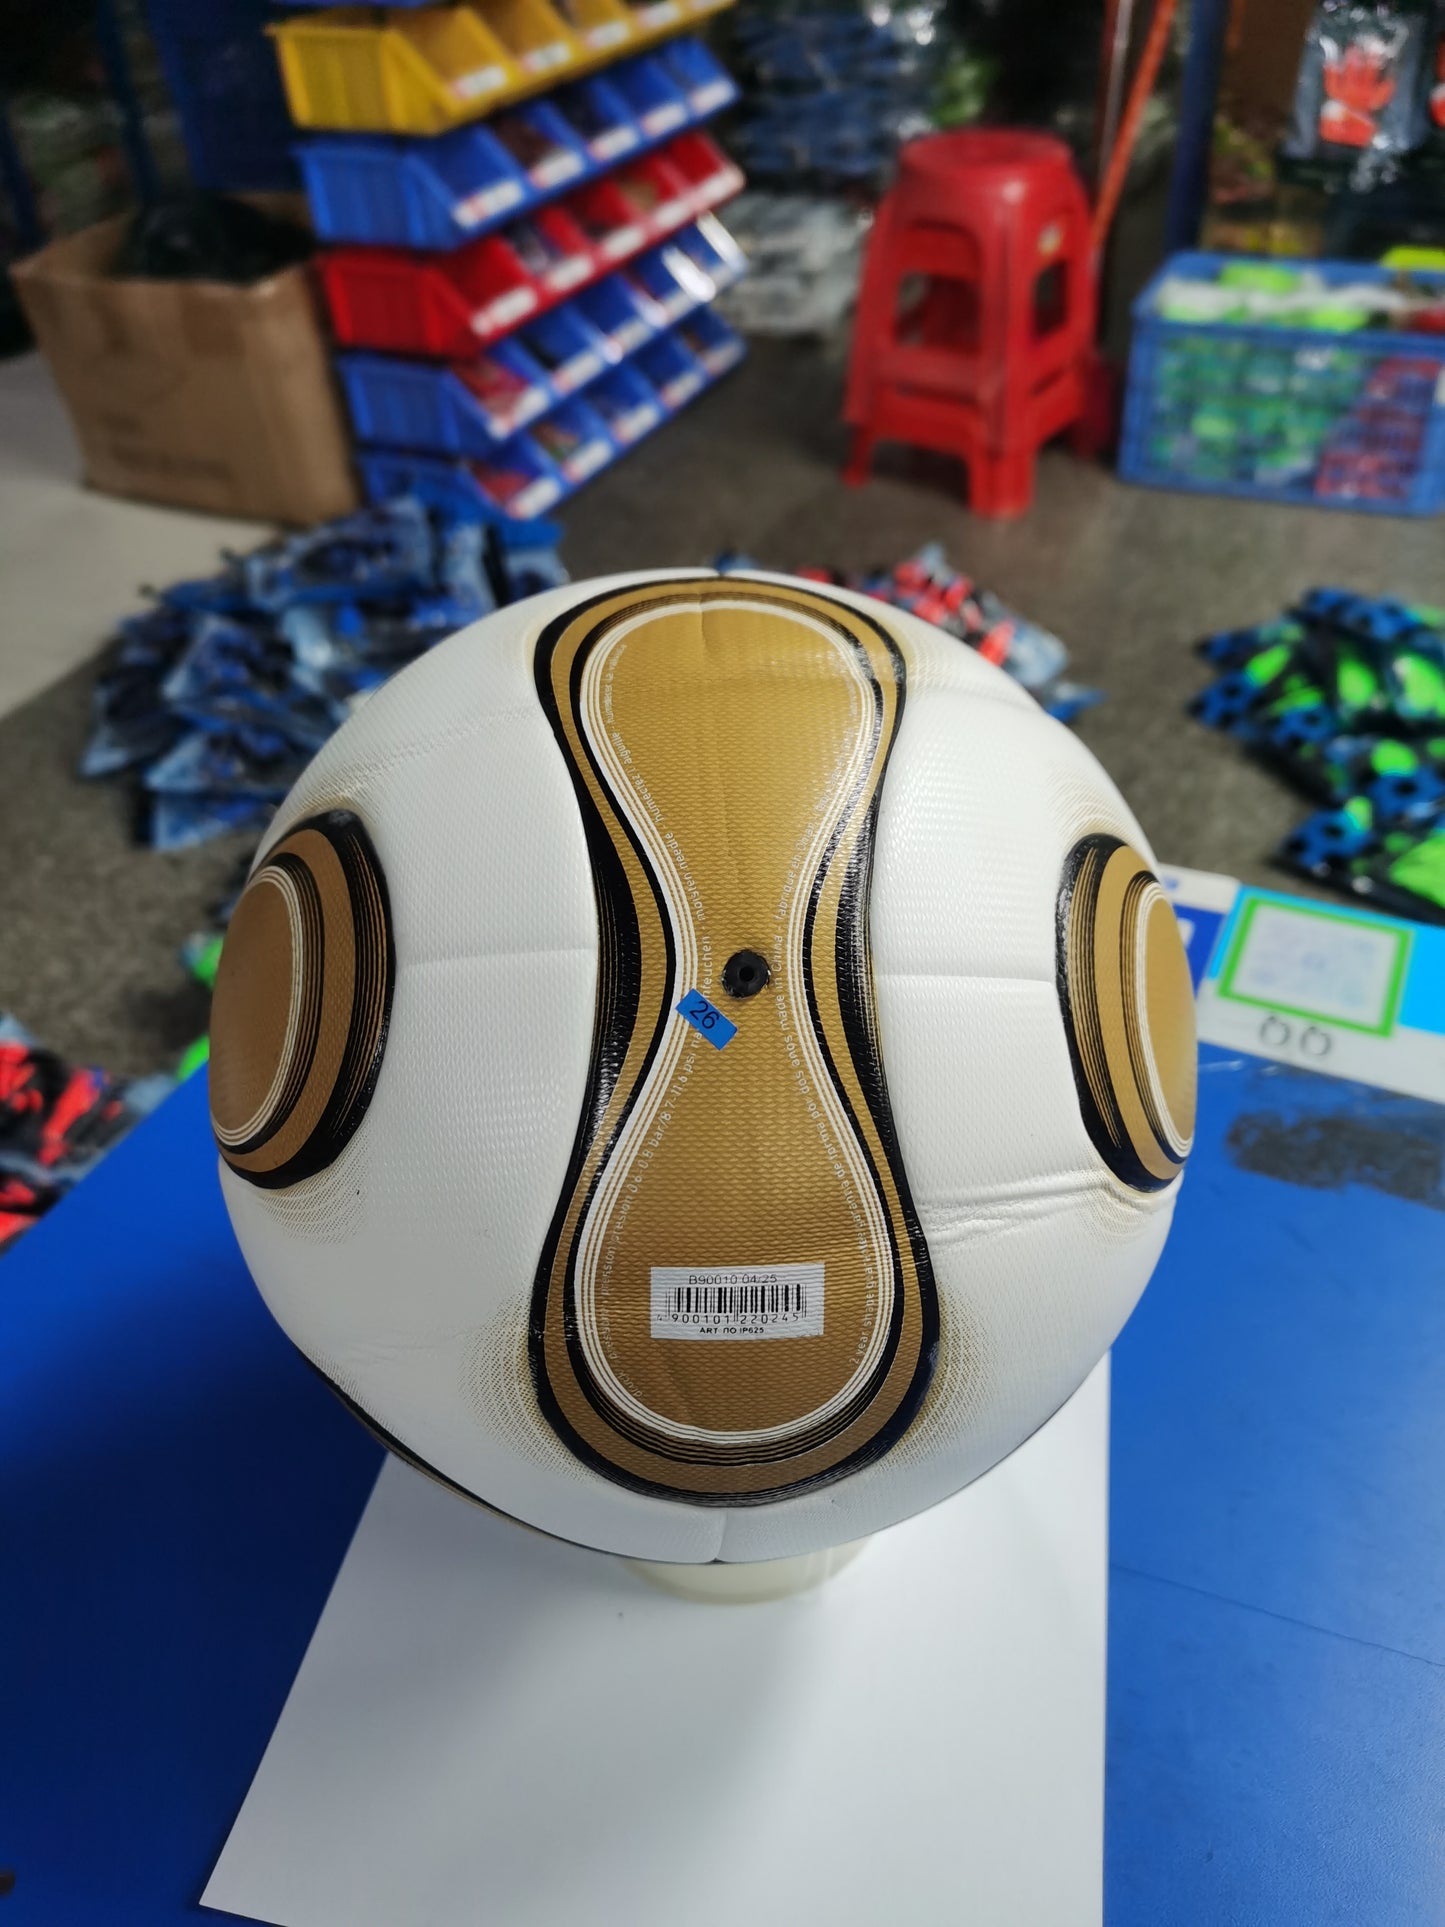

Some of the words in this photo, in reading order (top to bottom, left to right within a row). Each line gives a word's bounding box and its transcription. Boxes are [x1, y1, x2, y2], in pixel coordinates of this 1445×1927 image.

[632, 774, 663, 822] humectez
[665, 832, 687, 869] needle
[684, 872, 704, 920] moisten
[773, 934, 782, 971] China
[773, 976, 783, 989] in
[688, 1000, 720, 1030] 26
[776, 995, 789, 1030] made
[796, 1070, 809, 1093] dos
[806, 1098, 821, 1119] por
[834, 1163, 845, 1177] de
[688, 1274, 738, 1285] B90010
[671, 1313, 730, 1324] 900101
[740, 1312, 799, 1325] 220245
[855, 1331, 868, 1355] year
